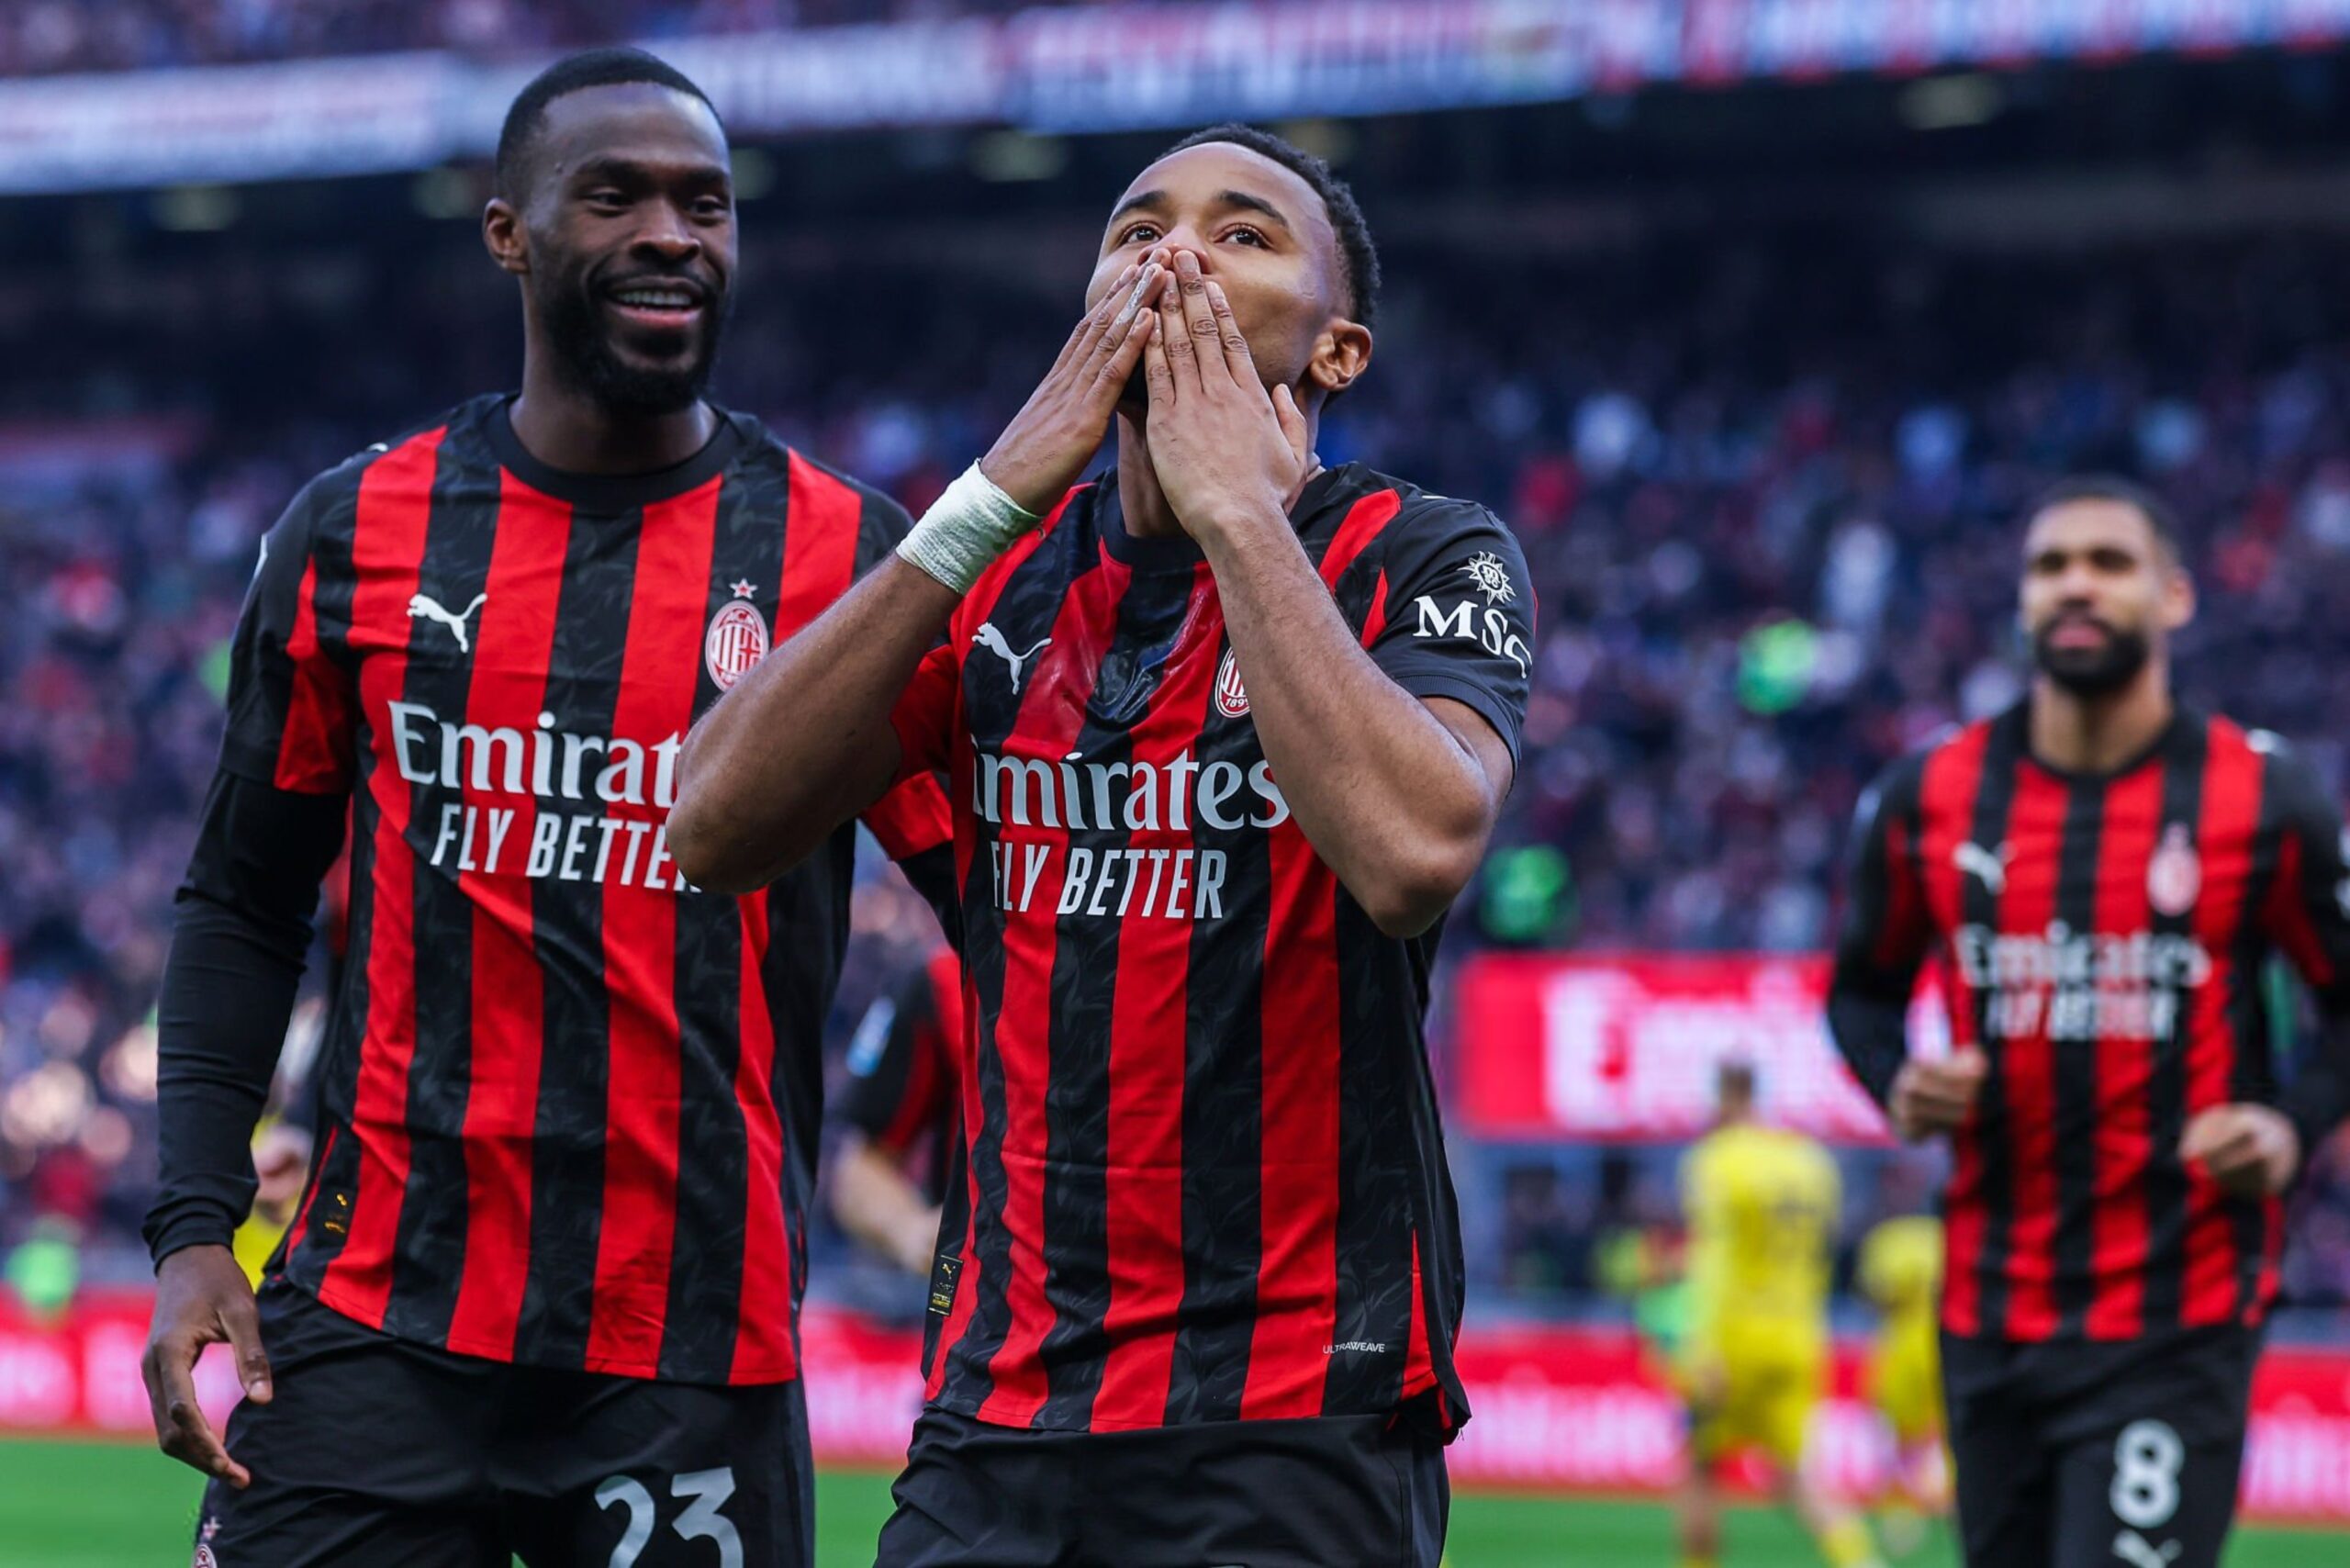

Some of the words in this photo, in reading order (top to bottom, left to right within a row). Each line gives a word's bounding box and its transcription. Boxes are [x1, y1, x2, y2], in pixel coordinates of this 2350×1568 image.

[1413, 595, 1533, 679] MSC
[387, 700, 681, 809] Emirat
[970, 734, 1291, 830] mirates
[430, 803, 515, 874] FLY
[526, 812, 702, 893] BETTE
[990, 840, 1050, 913] FLY
[1057, 847, 1227, 918] BETTER
[1322, 1340, 1386, 1354] ULTRAWEAVE
[594, 1467, 744, 1568] 23
[2109, 1418, 2185, 1529] 8
